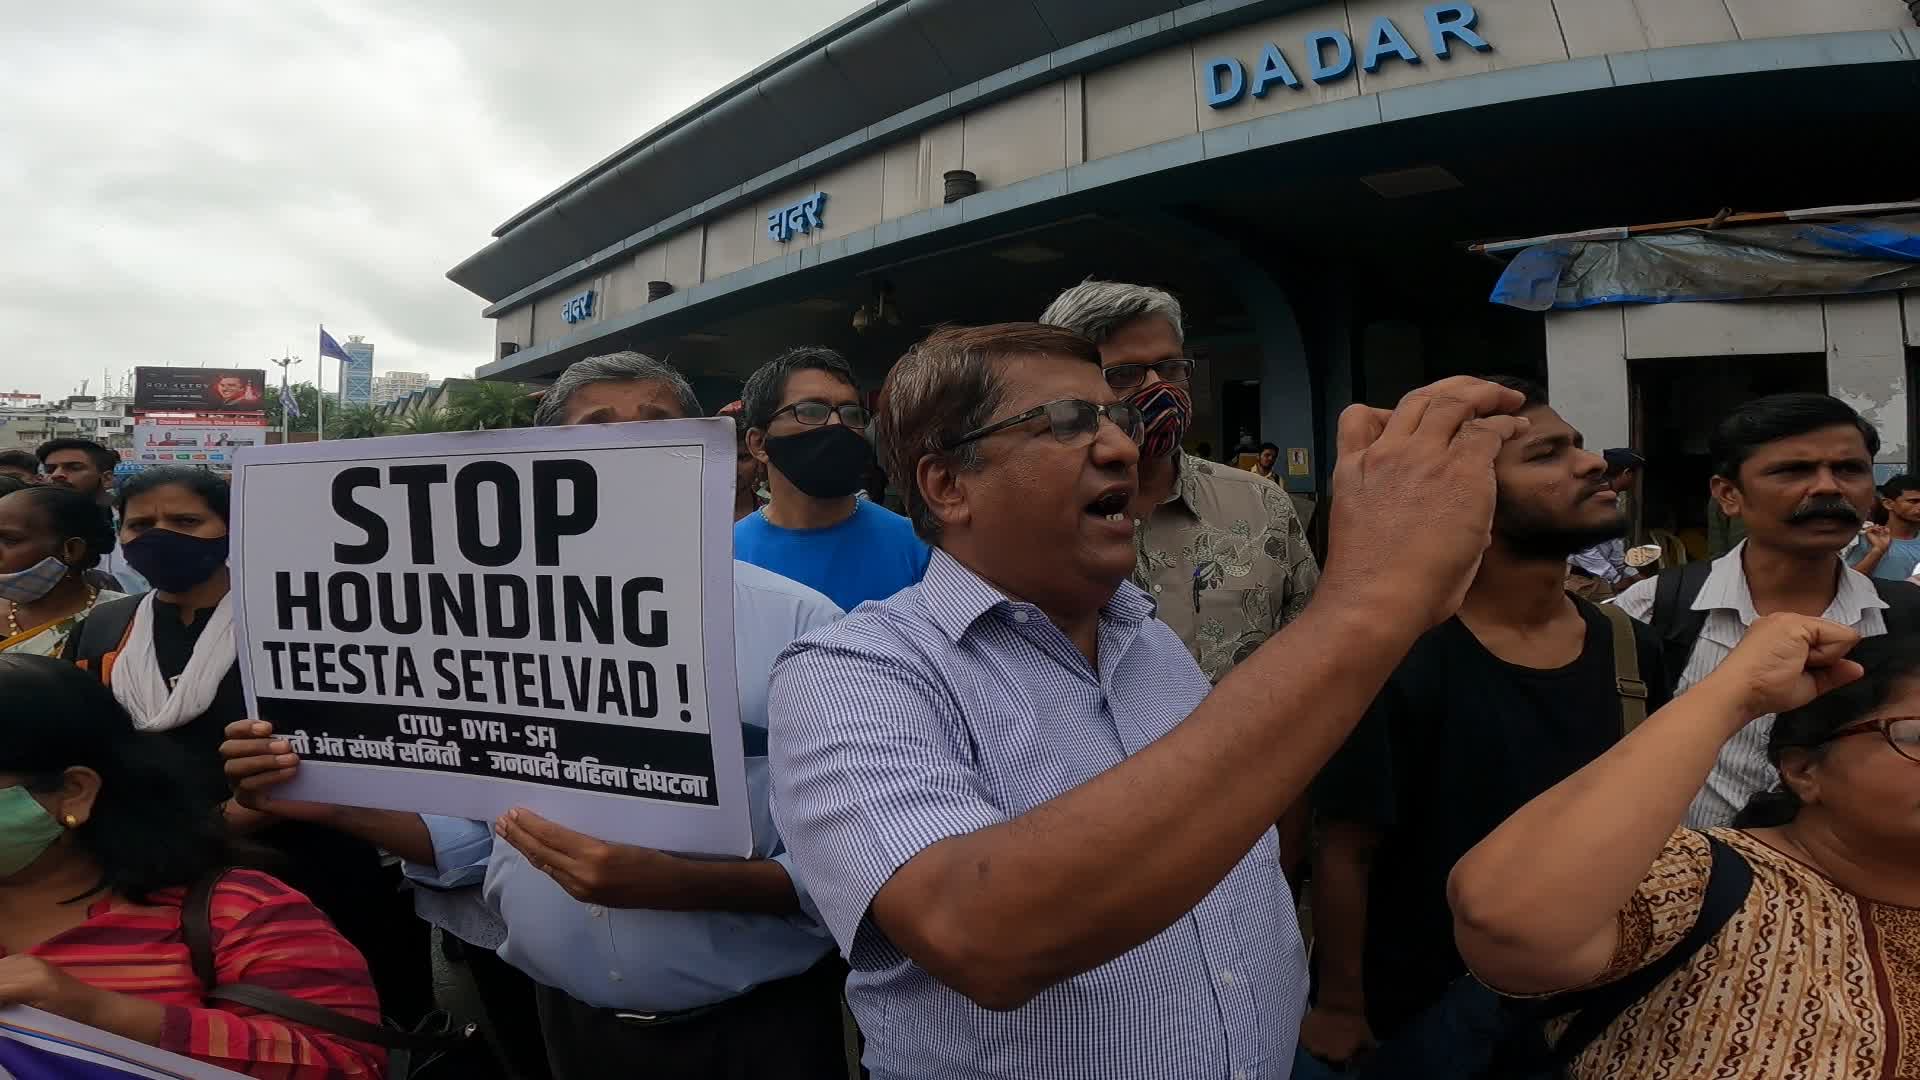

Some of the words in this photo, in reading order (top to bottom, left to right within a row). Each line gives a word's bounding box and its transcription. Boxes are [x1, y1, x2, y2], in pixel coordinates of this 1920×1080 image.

[1203, 0, 1492, 109] DADAR
[767, 191, 829, 243] दादर
[560, 289, 594, 324] दादर
[331, 458, 599, 567] STOP
[275, 570, 669, 648] HOUNDING
[262, 641, 425, 698] TEESTA
[433, 648, 659, 719] SETELVAD
[676, 663, 692, 723] !
[312, 732, 345, 757] अंत
[346, 734, 396, 761] संघर्ष
[396, 738, 462, 767] समिती
[486, 751, 560, 780] जनवादी
[561, 756, 629, 789] महिला
[630, 763, 709, 798] संघटना
[398, 713, 444, 737] CITU
[460, 718, 508, 744] DYFI
[524, 724, 557, 749] SFI
